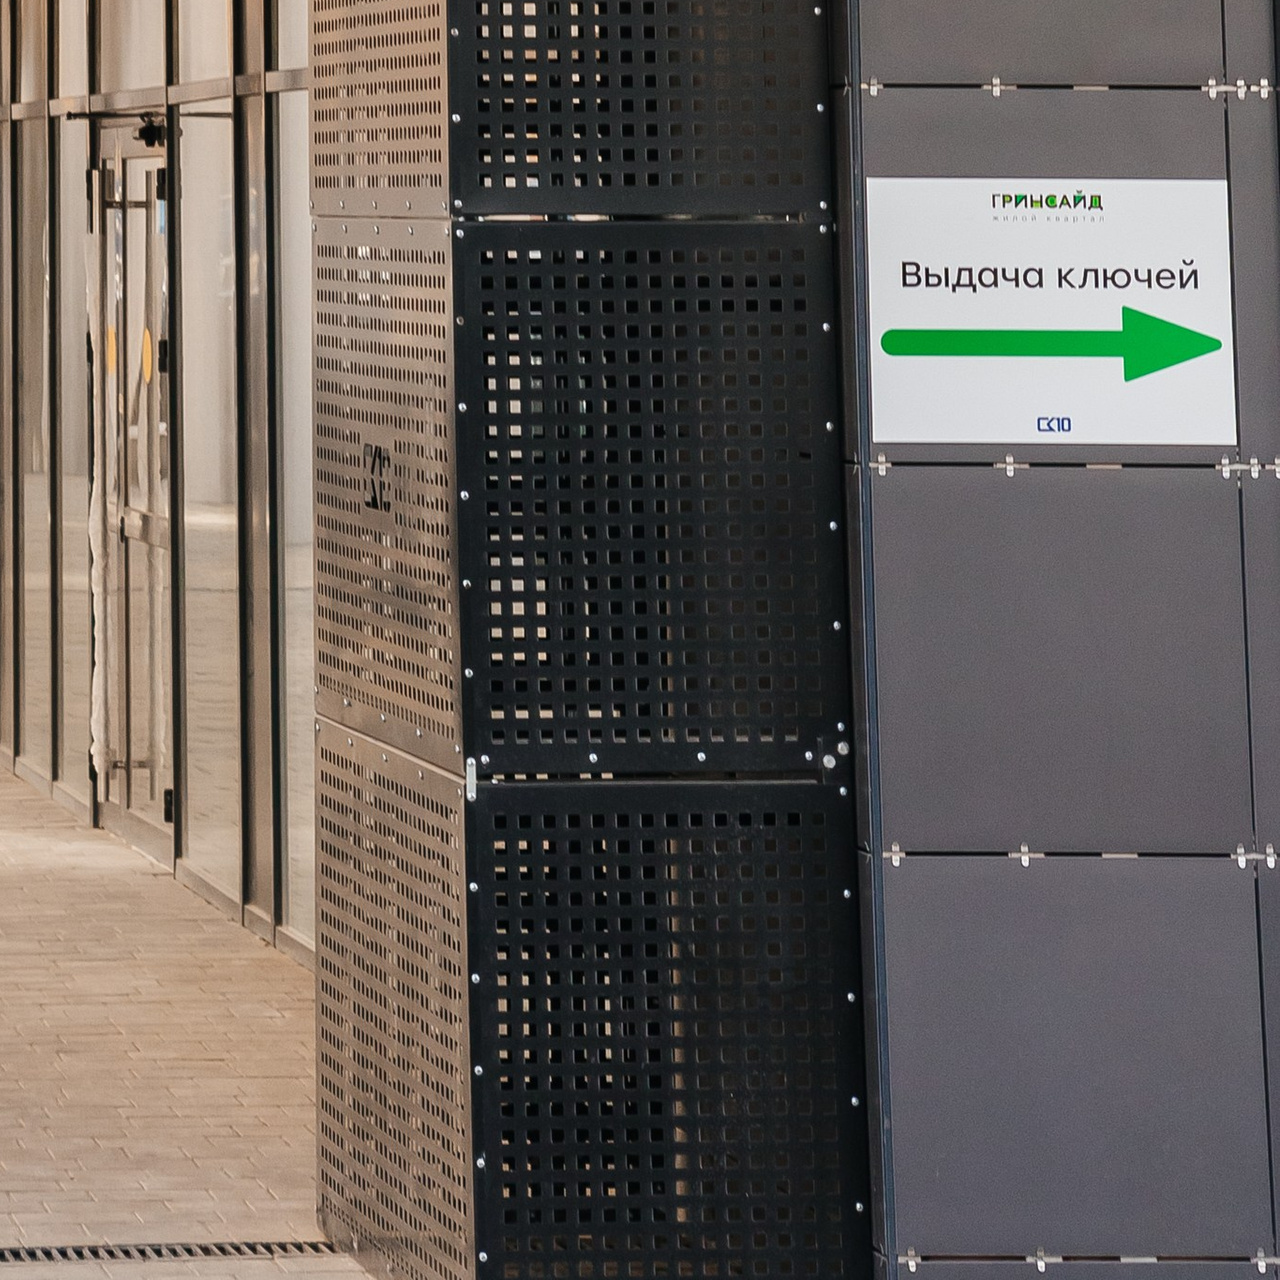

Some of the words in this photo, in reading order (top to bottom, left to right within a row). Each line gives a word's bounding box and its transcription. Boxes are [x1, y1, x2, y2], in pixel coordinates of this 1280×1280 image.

[991, 189, 1104, 211] ГРИНСАЙД
[992, 213, 1038, 223] жилой
[1045, 214, 1106, 225] квартал
[901, 261, 1044, 293] Выдача
[1057, 259, 1199, 290] ключей
